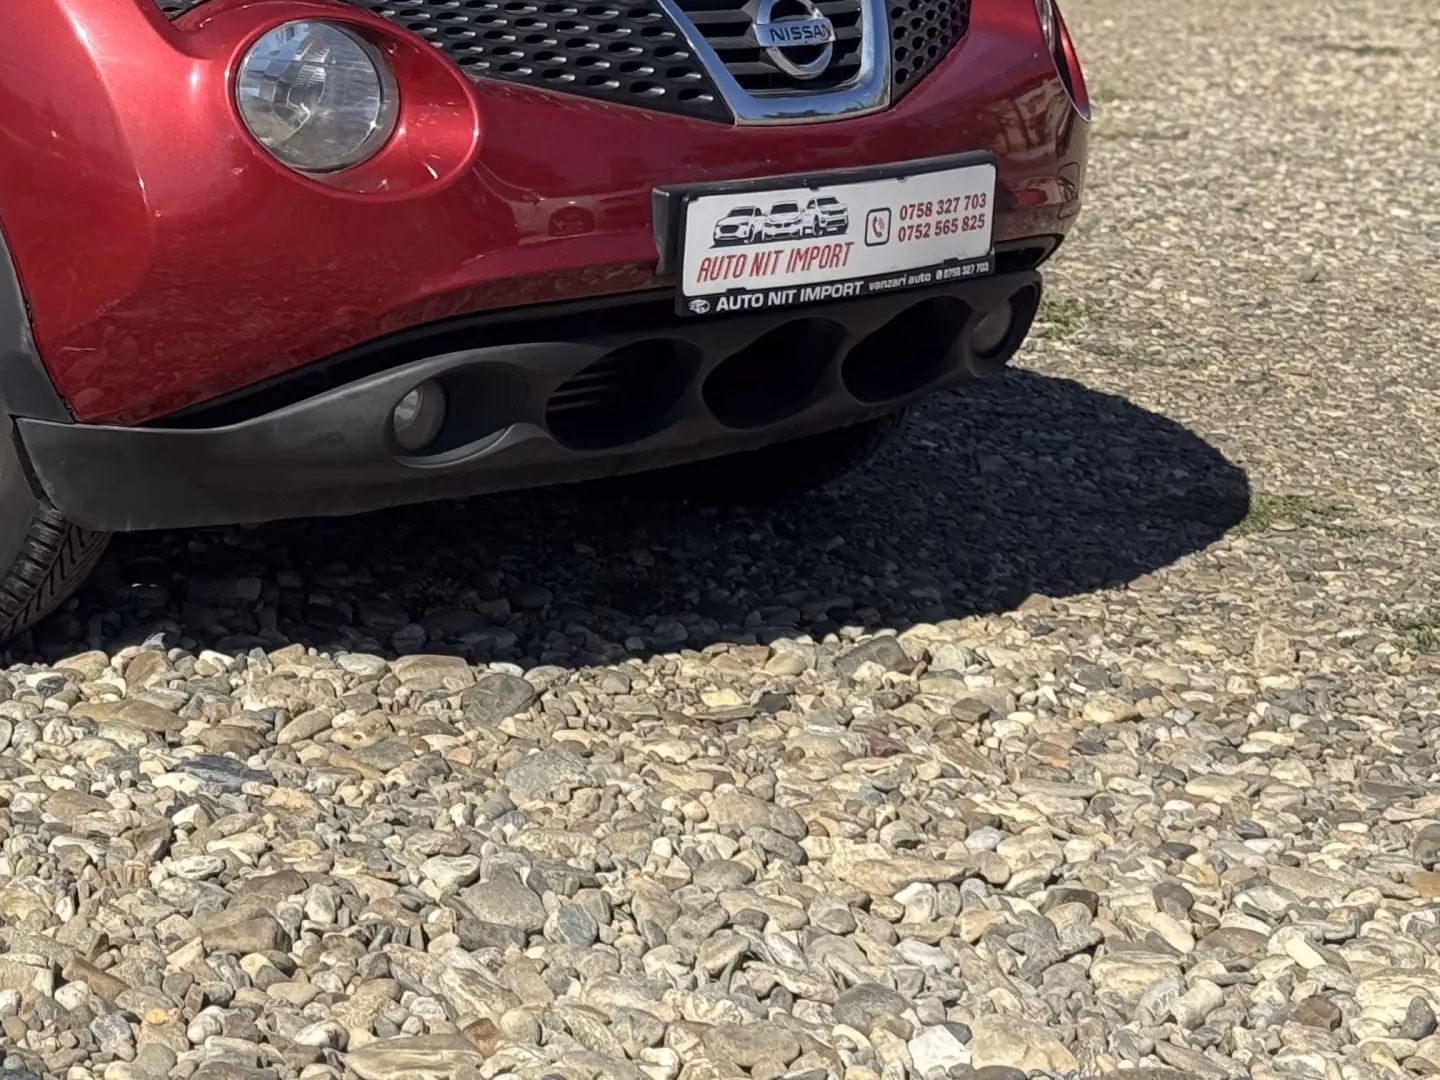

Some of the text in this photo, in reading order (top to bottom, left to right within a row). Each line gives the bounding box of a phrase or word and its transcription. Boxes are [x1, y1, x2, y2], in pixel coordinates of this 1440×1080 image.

[769, 23, 832, 43] NISSAN
[900, 192, 987, 221] 0758 327 703
[898, 213, 985, 242] 0752 565 825
[696, 242, 854, 283] AUTO NIT IMPORT
[716, 293, 764, 312] AUTO
[767, 289, 797, 306] NIT
[799, 281, 864, 301] IMPORT
[908, 271, 932, 285] auto
